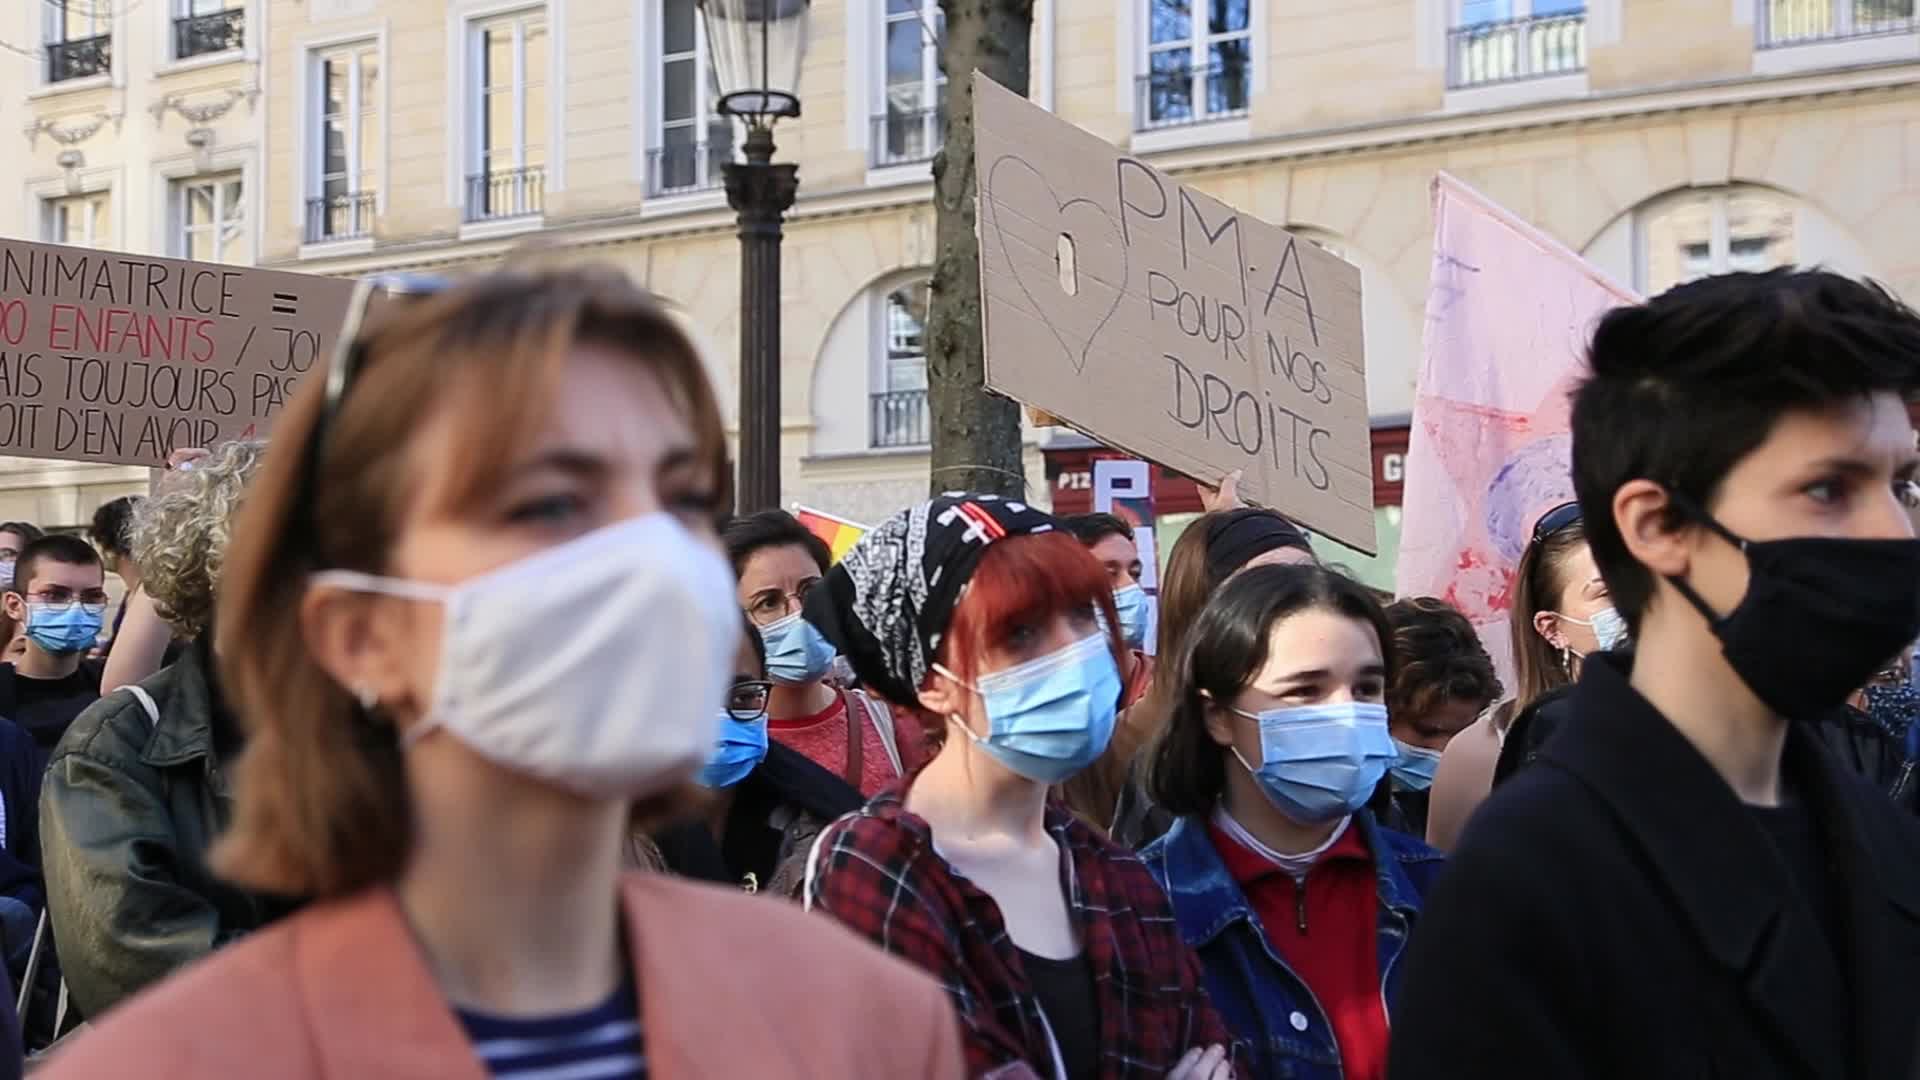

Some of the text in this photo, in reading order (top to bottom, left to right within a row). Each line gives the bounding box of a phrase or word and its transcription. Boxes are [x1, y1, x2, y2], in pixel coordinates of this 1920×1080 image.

[2, 248, 244, 318] NIMATRICE
[49, 303, 216, 363] ENFANTS
[1148, 270, 1333, 404] POUR NOS
[60, 355, 237, 416] TOUJOURS
[55, 406, 124, 457] D'EN
